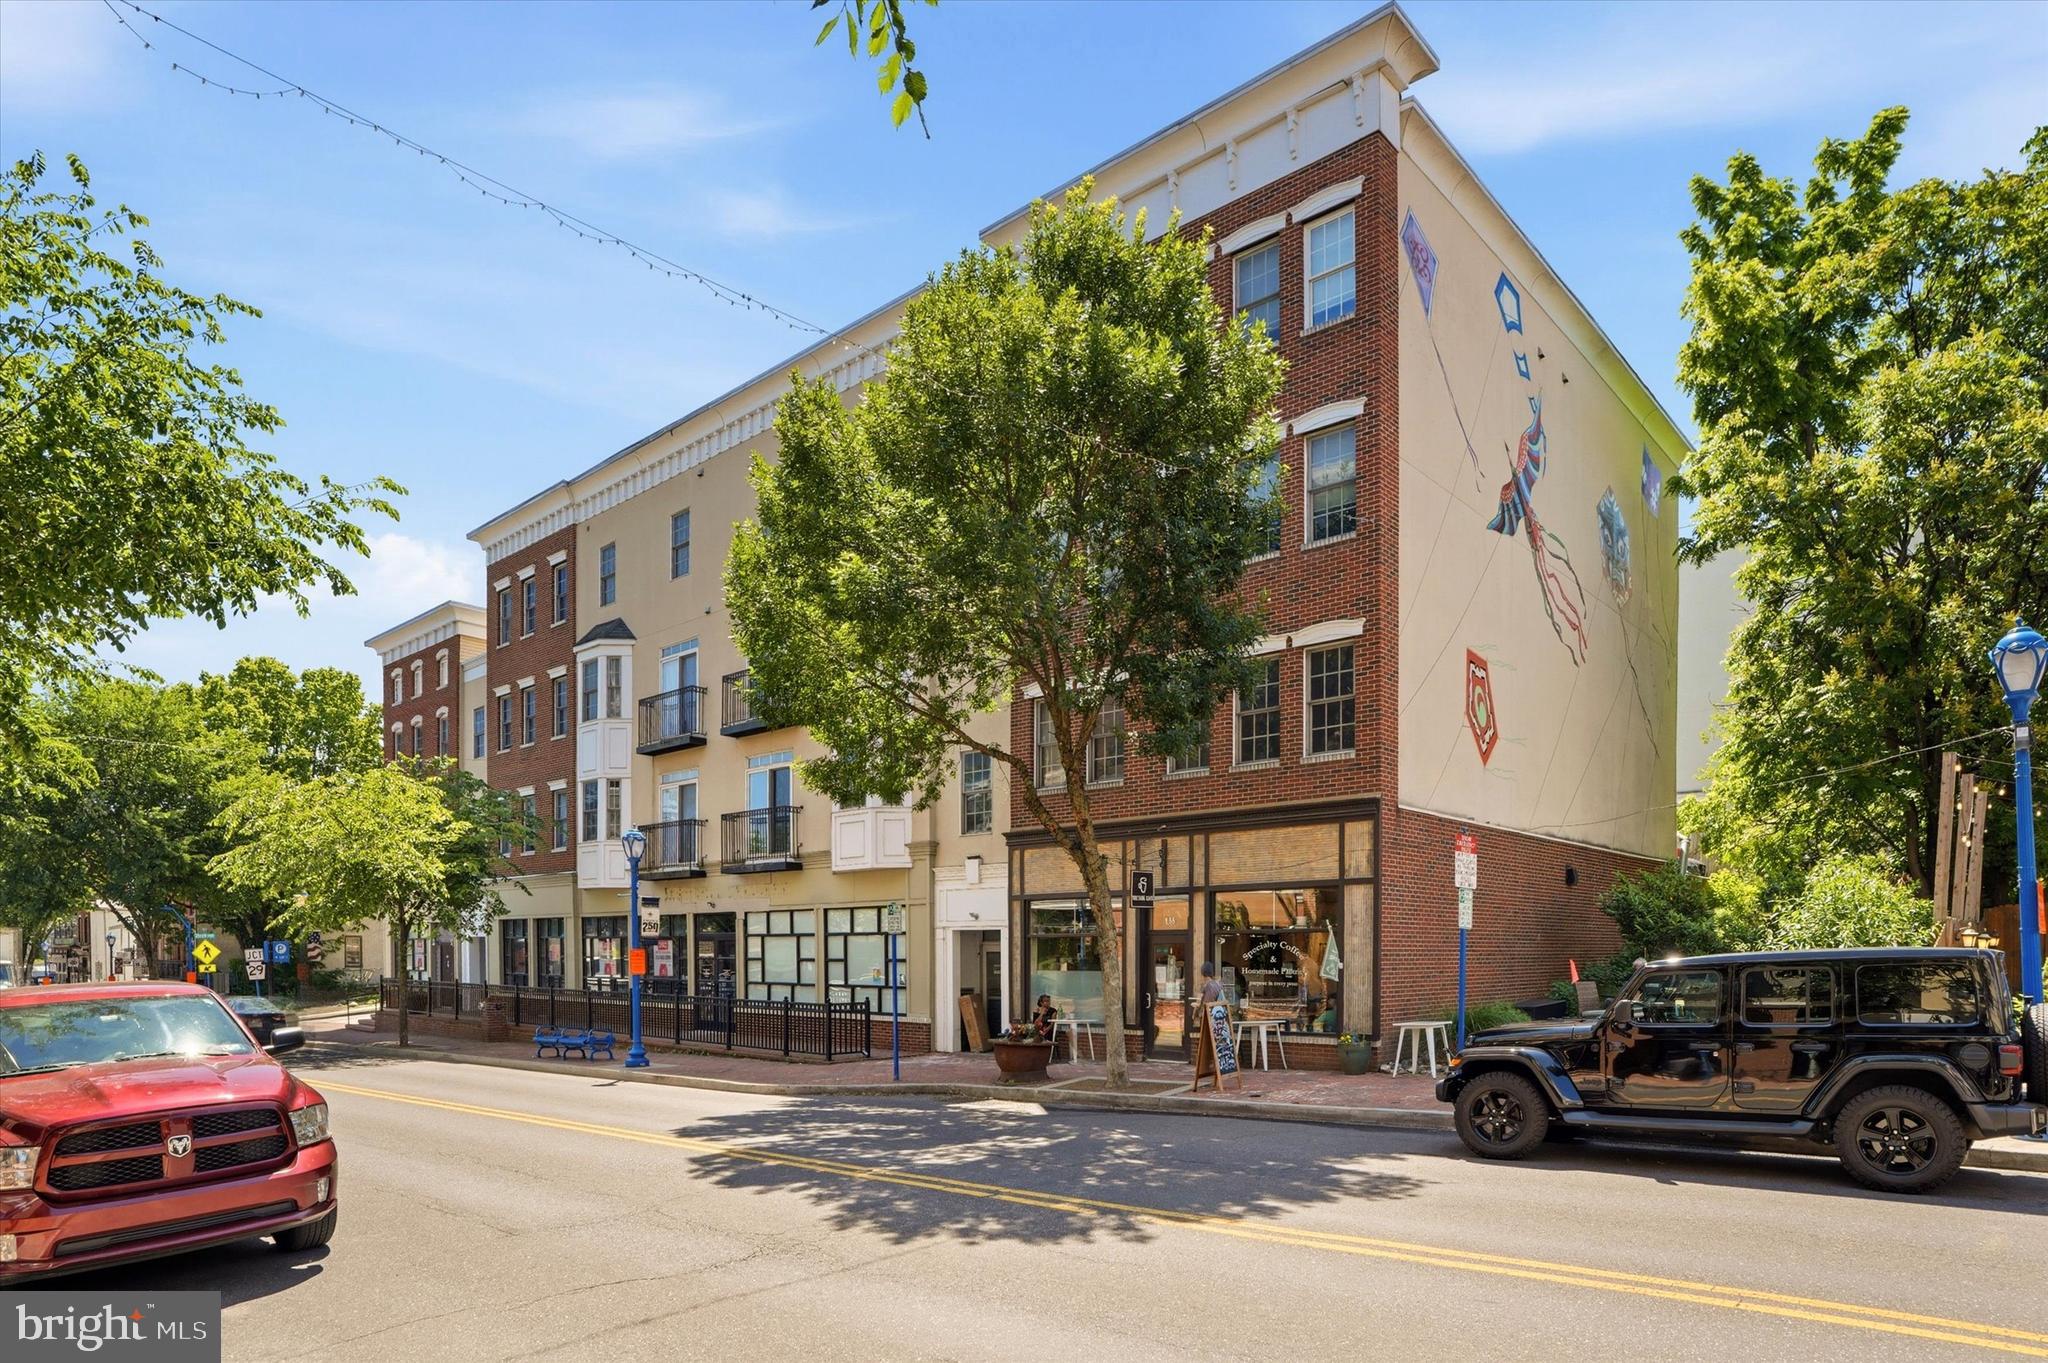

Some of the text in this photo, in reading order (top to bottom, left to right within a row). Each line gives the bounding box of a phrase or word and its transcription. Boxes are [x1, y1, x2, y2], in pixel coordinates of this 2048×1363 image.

[247, 951, 262, 960] JCT
[1242, 940, 1278, 961] Specialty
[1280, 941, 1306, 961] Coffee
[248, 965, 264, 976] 29
[1241, 967, 1279, 975] Homemade
